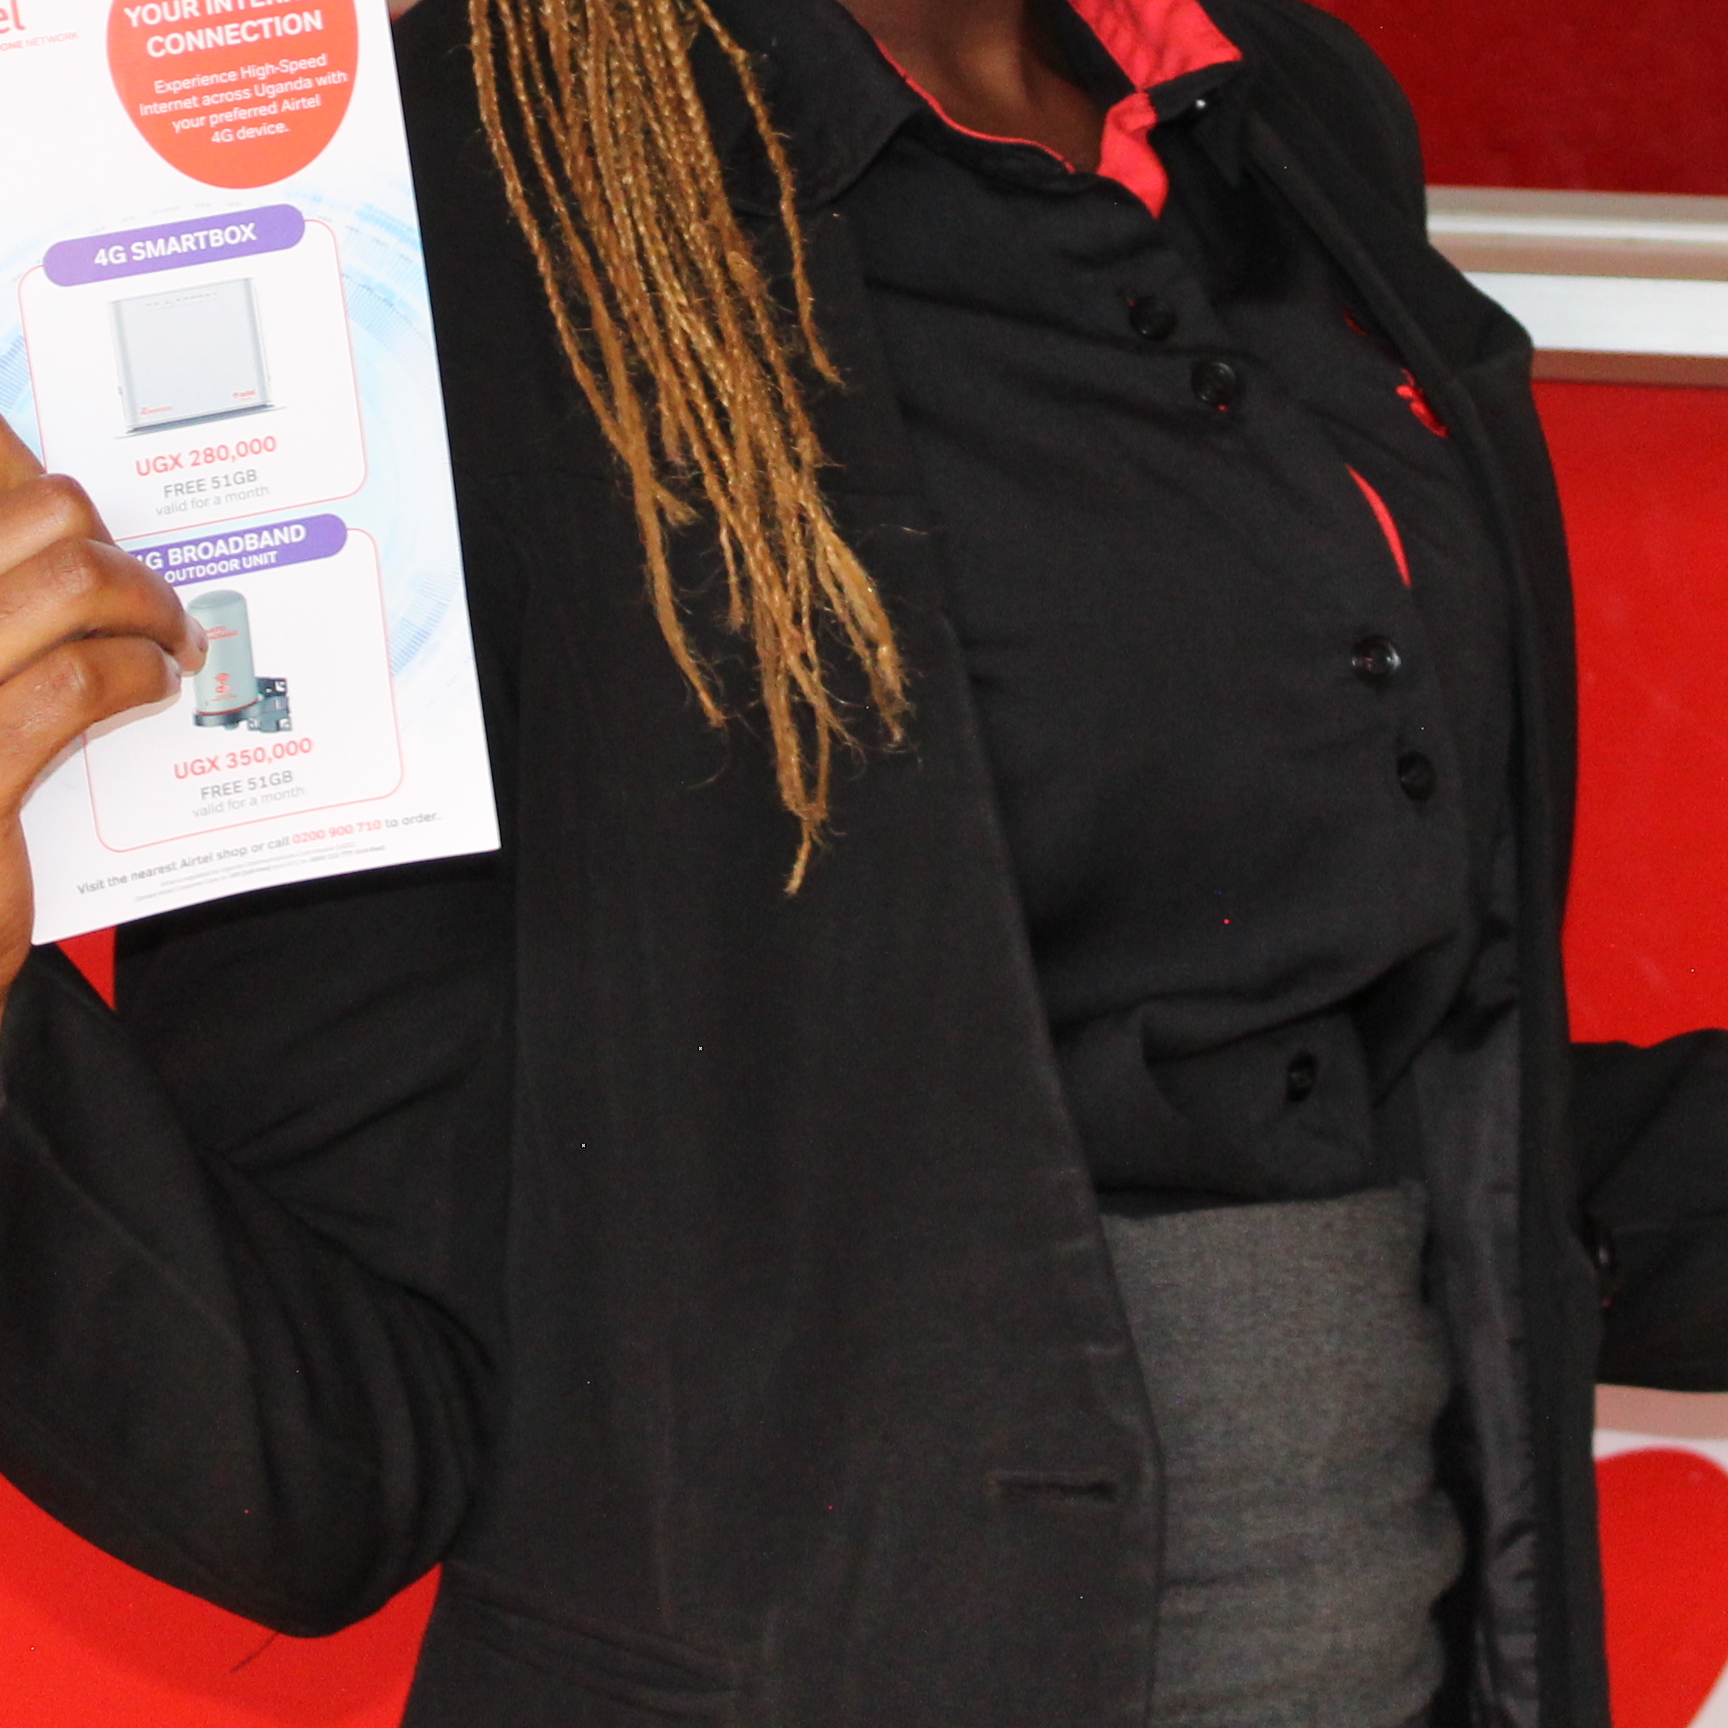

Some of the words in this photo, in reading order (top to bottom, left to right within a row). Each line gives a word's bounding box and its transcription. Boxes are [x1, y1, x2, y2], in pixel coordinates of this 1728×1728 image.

[25, 31, 80, 48] NETWORK
[146, 9, 324, 58] CONNECTION
[140, 95, 199, 116] Internet
[202, 87, 252, 106] across
[254, 77, 313, 99] Uganda
[316, 70, 348, 86] with
[154, 69, 237, 96] Experience
[240, 53, 328, 81] High-Speed
[172, 116, 207, 134] your
[209, 101, 278, 128] preferred
[281, 94, 322, 113] Airtel
[211, 128, 235, 144] 4G
[236, 122, 290, 141] device.
[94, 245, 127, 268] 4G
[130, 223, 258, 261] SMARTBOX
[136, 453, 184, 477] UGX
[188, 436, 277, 467] 280,000
[155, 500, 188, 517] valid
[191, 496, 209, 510] for
[213, 495, 222, 505] a
[224, 484, 270, 504] month
[163, 478, 207, 499] FREE
[211, 469, 258, 490] 51GB
[136, 552, 163, 571] G
[167, 524, 306, 566] BROADBAND
[164, 557, 241, 584] OUTDOOR
[242, 550, 279, 570] UNIT
[173, 756, 221, 780] UGX
[225, 736, 313, 770] 350,000
[192, 802, 224, 818] valid
[227, 798, 246, 811] for
[249, 797, 258, 806] a
[260, 786, 305, 805] month
[200, 780, 243, 801] FREE
[247, 770, 294, 791] 51GB
[76, 879, 105, 895] Visit
[107, 873, 128, 888] the
[130, 861, 177, 882] nearest
[180, 852, 214, 870] Airtel
[216, 846, 248, 862] shop
[251, 843, 265, 854] or
[267, 836, 290, 851] call
[329, 823, 354, 838] 900
[357, 819, 383, 833] 710
[385, 818, 399, 829] to
